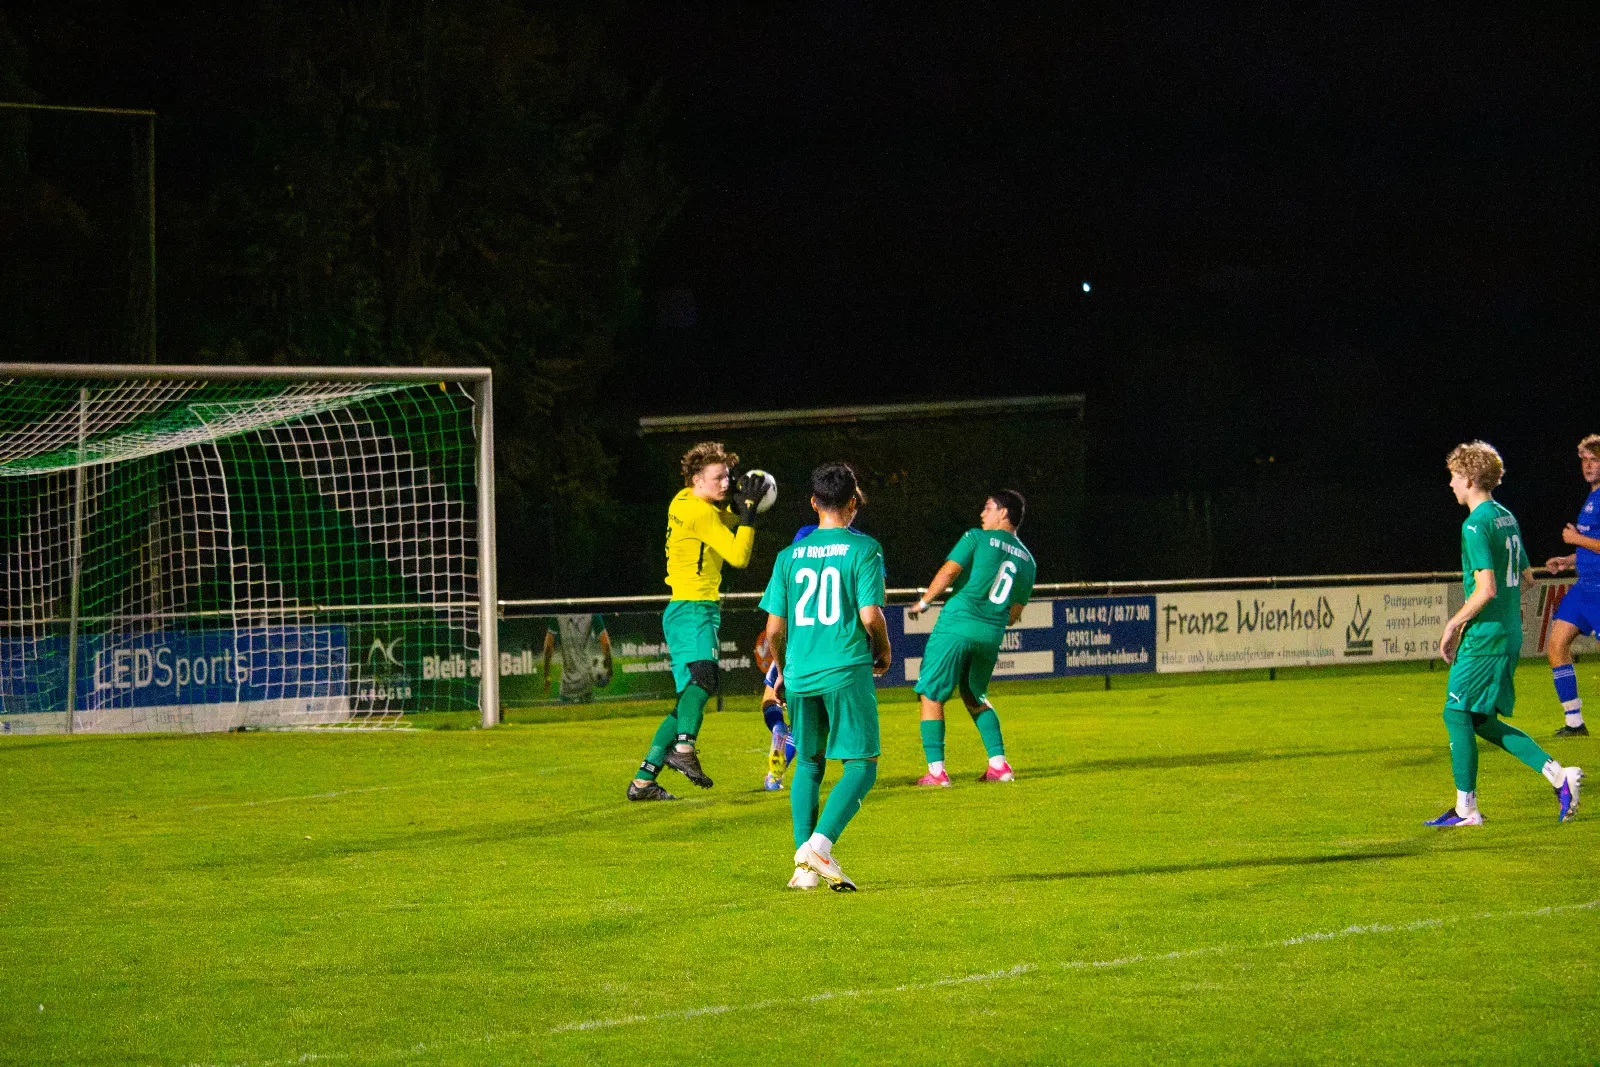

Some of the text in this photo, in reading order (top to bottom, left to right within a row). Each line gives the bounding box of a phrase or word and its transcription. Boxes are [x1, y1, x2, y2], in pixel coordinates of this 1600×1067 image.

[795, 566, 841, 626] 20
[989, 560, 1017, 604] 6
[1065, 607, 1079, 624] Tel.
[1125, 605, 1135, 621] 77
[1162, 596, 1335, 642] Franz Wienhold
[422, 653, 466, 680] Bleib
[500, 650, 537, 677] Ball.
[1382, 636, 1400, 654] Tel.
[93, 647, 249, 697] LEDSports
